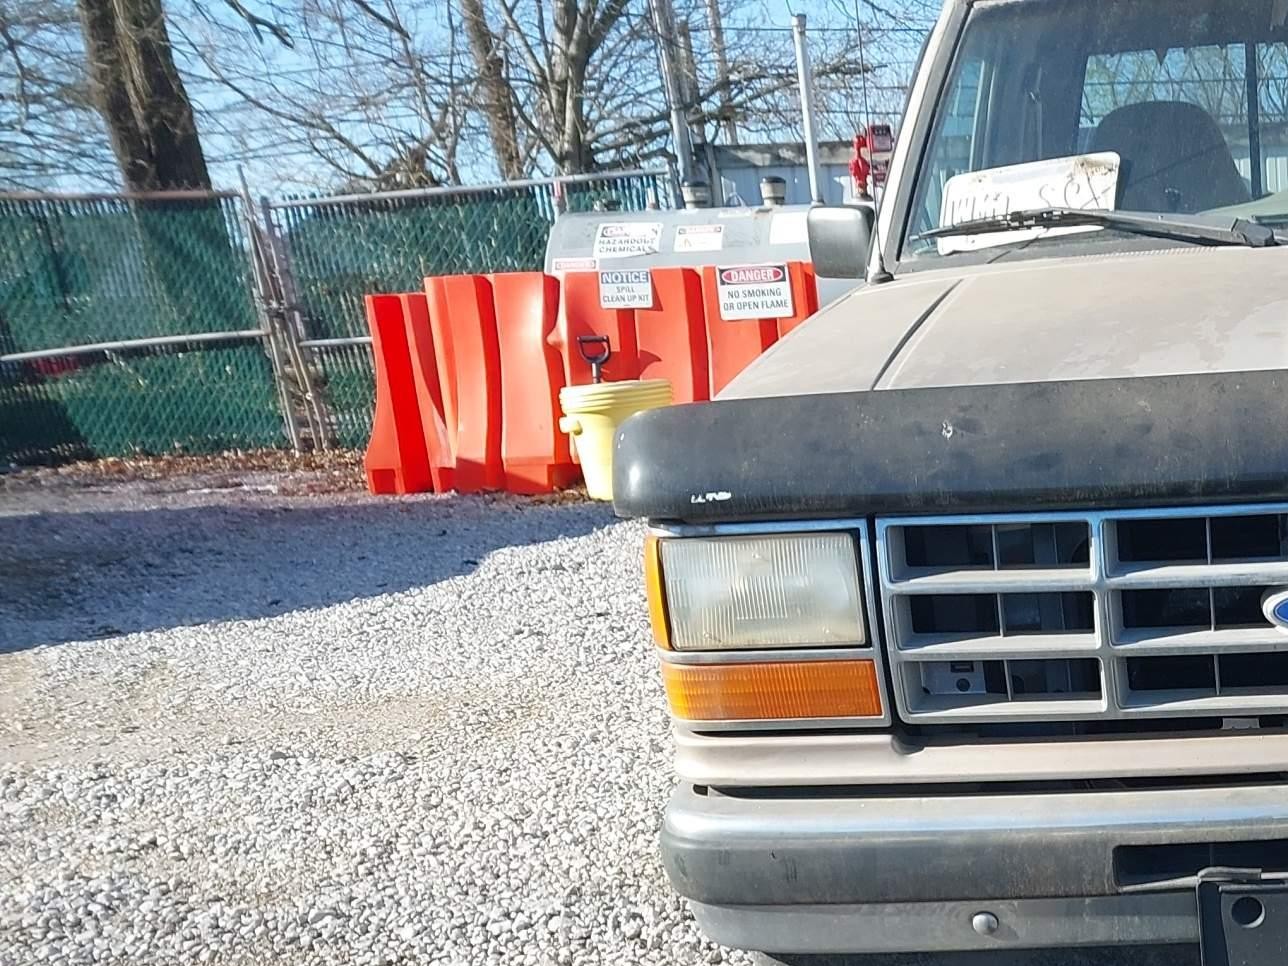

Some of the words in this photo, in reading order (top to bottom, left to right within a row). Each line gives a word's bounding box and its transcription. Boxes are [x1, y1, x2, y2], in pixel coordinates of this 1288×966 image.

[602, 271, 648, 283] NOTICE
[731, 269, 774, 282] DANGER
[727, 290, 740, 299] NO
[741, 287, 782, 299] SMOKING
[723, 302, 735, 311] OR
[736, 301, 759, 310] OPEN
[761, 299, 789, 309] FLAME
